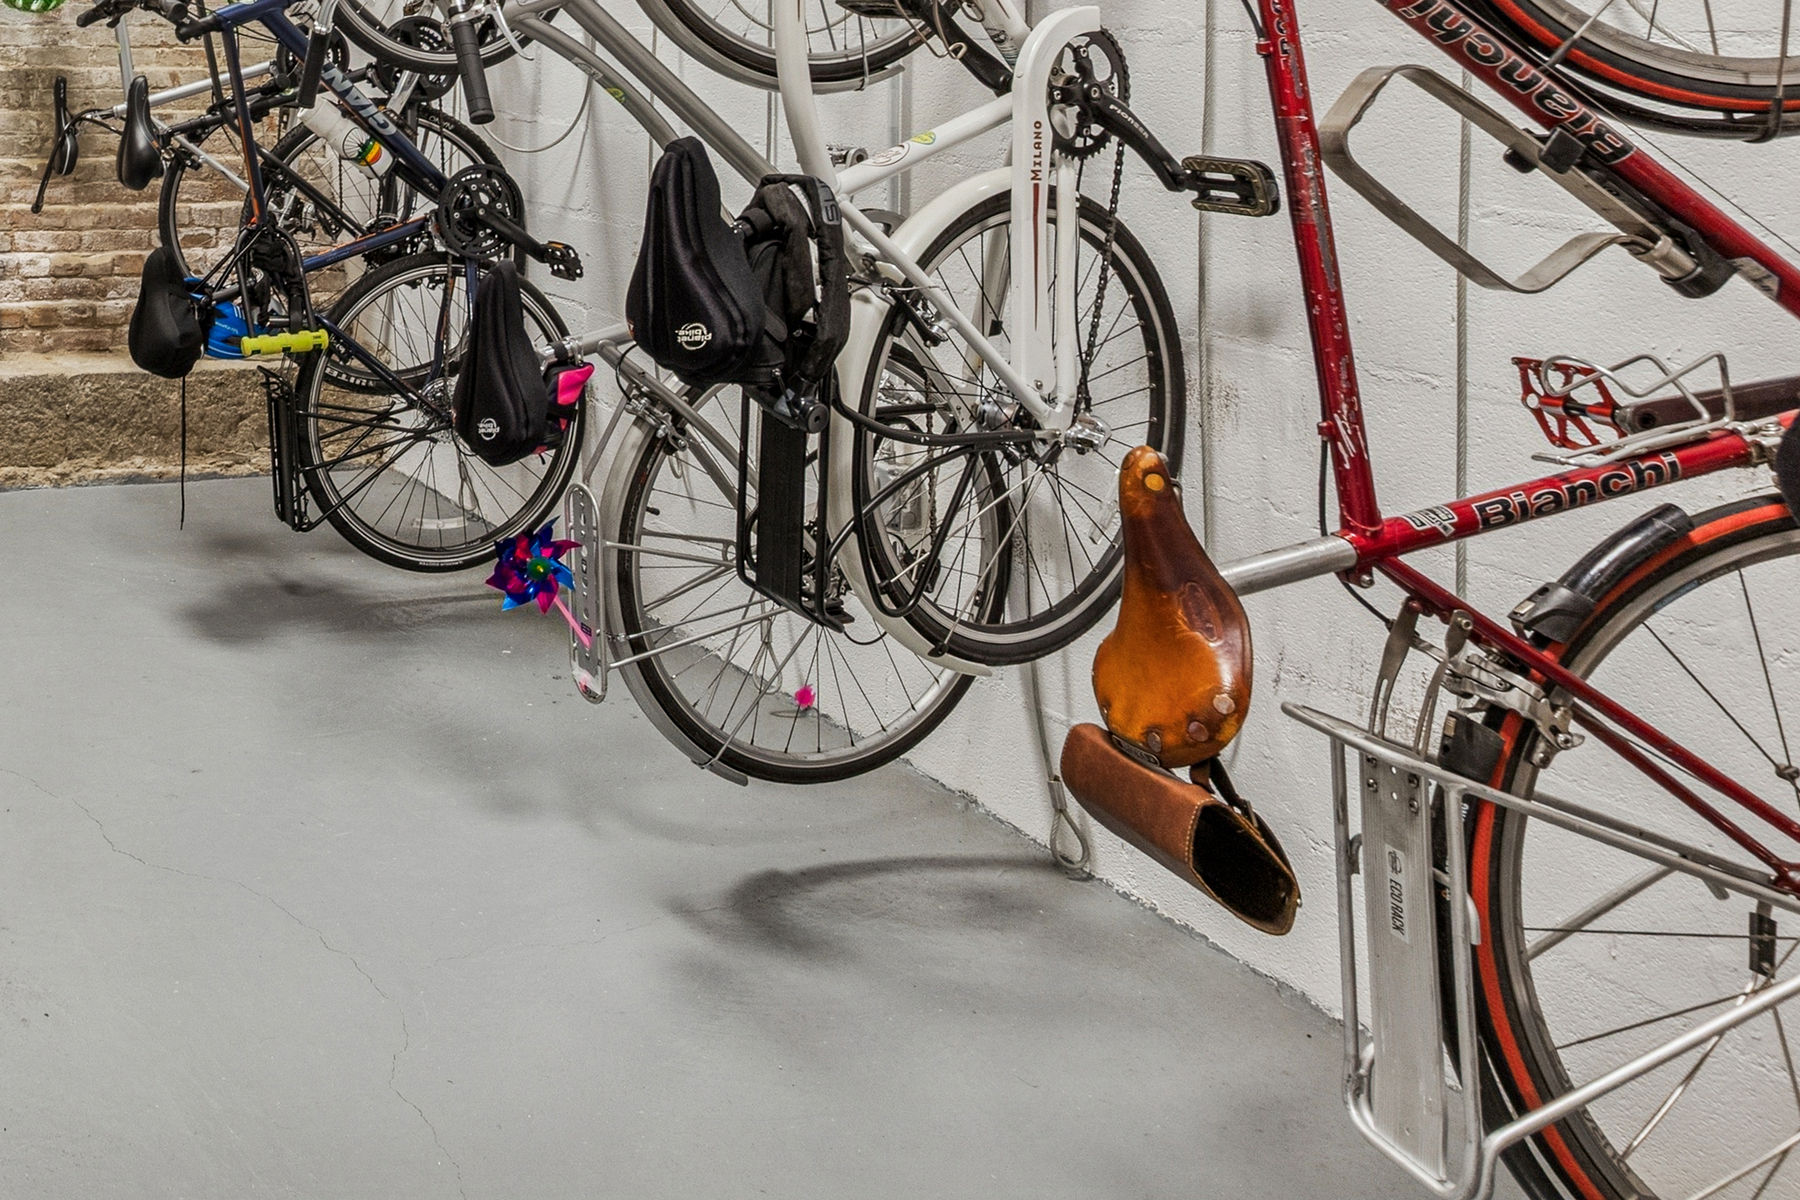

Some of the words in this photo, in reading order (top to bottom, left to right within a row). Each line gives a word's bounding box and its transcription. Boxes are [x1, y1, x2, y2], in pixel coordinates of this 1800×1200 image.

[321, 62, 398, 137] GIAN
[1109, 103, 1150, 140] PIONEER
[1030, 120, 1043, 181] MILANO
[676, 333, 713, 343] planet
[1471, 451, 1684, 532] Bianchi
[1389, 878, 1404, 905] ECO
[1390, 900, 1406, 936] RACK
